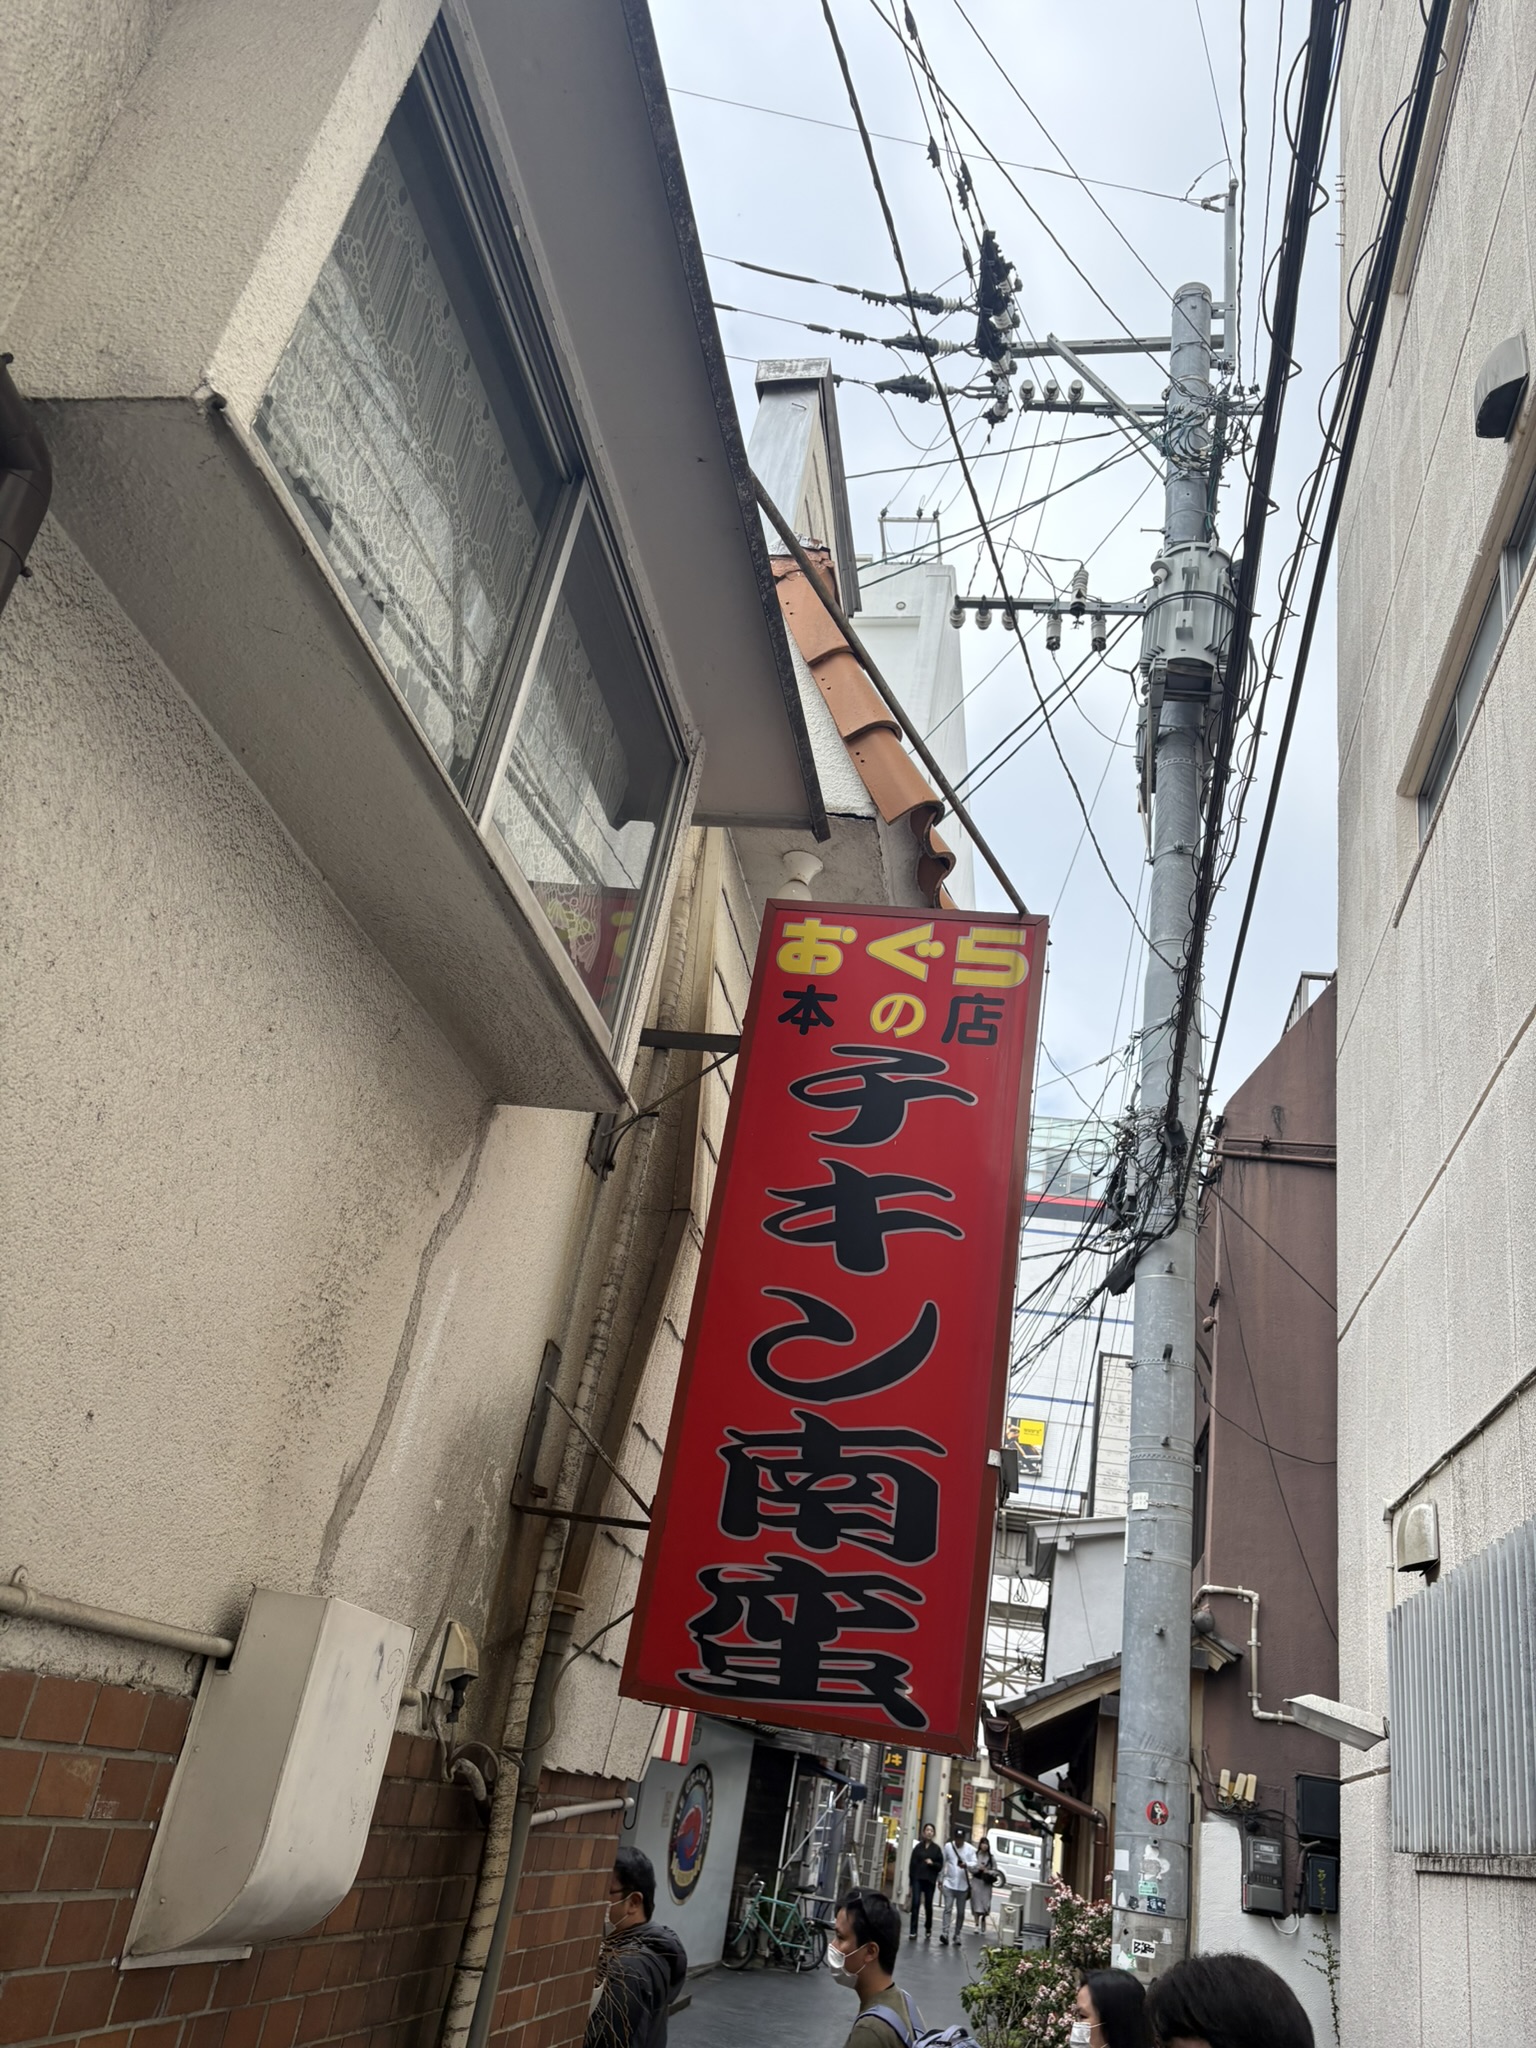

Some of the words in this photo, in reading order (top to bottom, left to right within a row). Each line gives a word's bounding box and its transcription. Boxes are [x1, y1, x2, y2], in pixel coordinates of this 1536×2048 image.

[776, 918, 1029, 988] おぐら
[675, 1044, 978, 1730] チキン南蛮
